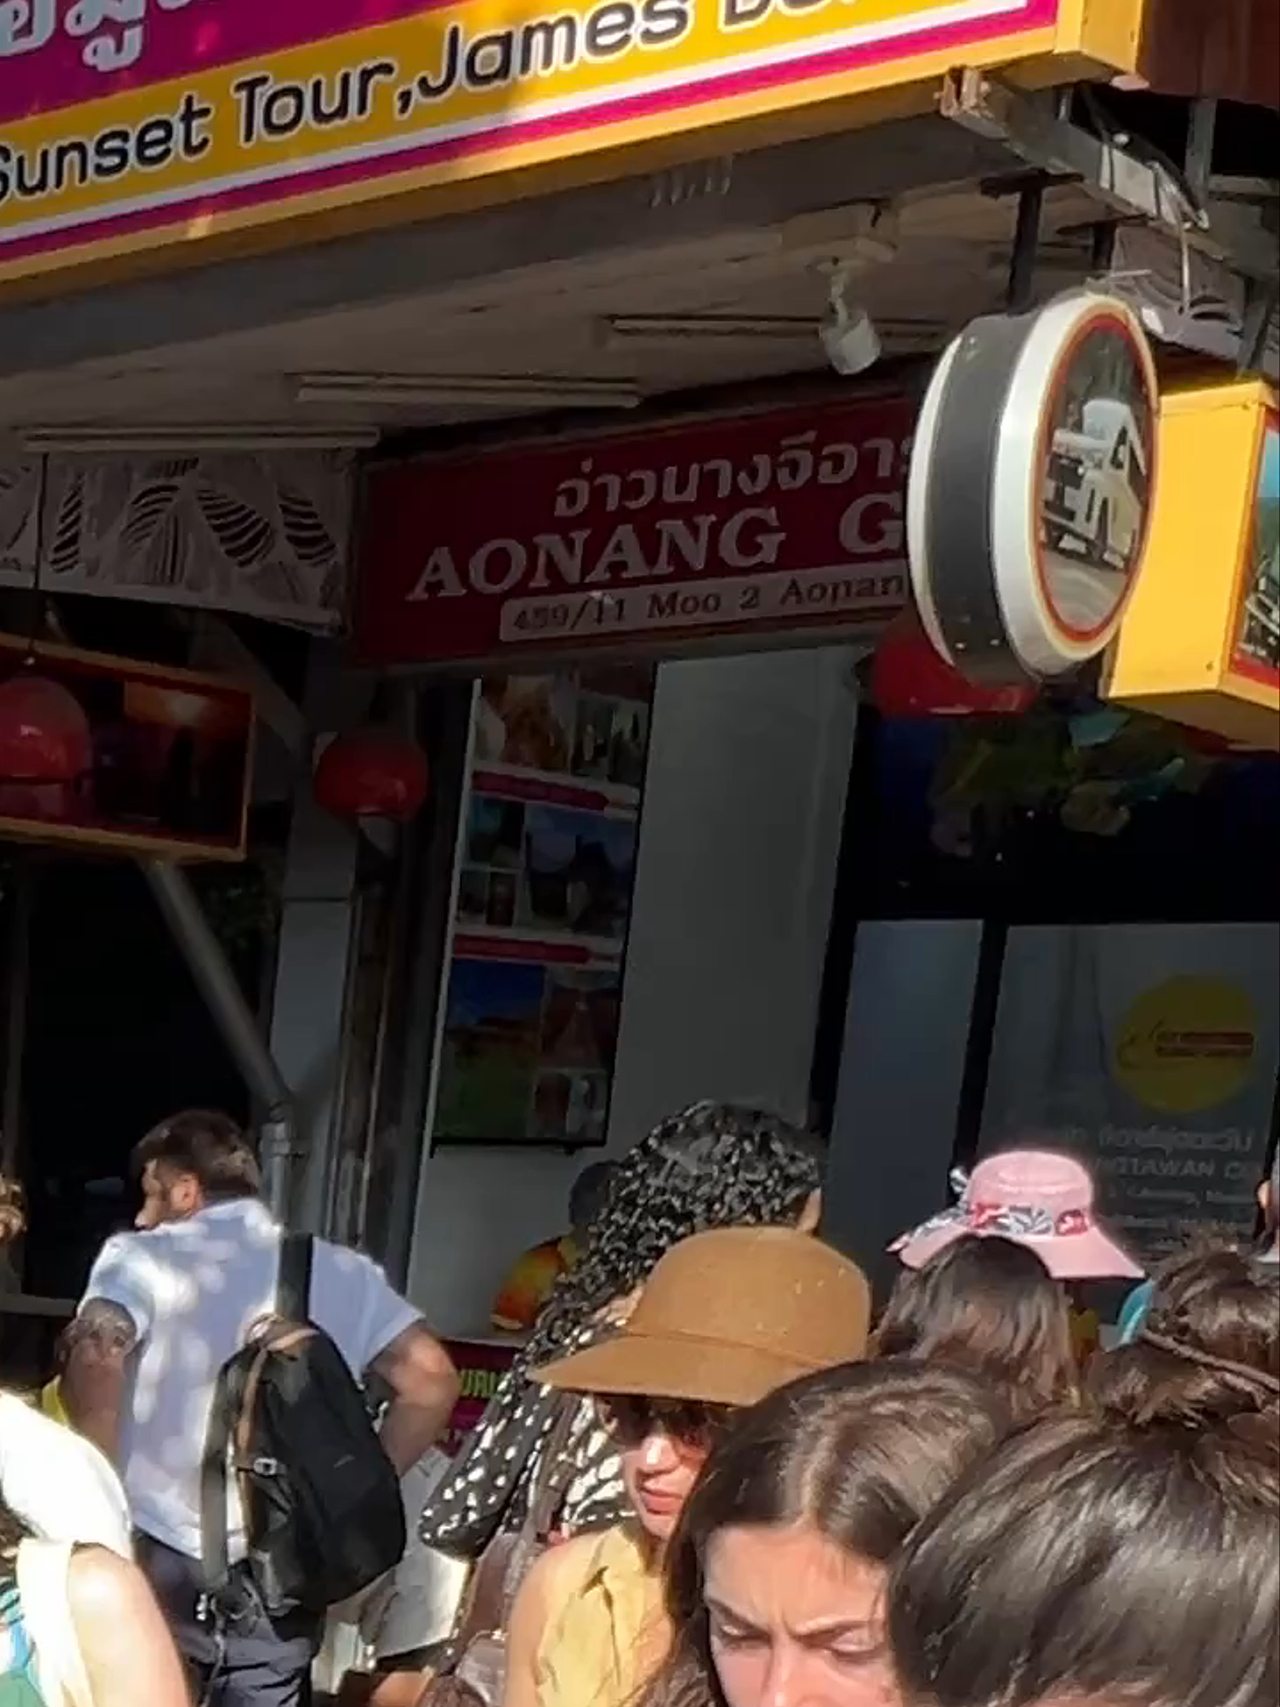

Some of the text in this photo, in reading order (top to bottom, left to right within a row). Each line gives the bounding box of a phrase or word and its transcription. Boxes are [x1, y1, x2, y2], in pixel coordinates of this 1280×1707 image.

[235, 0, 692, 146] Tour,James
[405, 492, 905, 602] AONANG G
[647, 589, 722, 620] Moo
[739, 584, 761, 609] 2
[780, 574, 908, 606] Aonan
